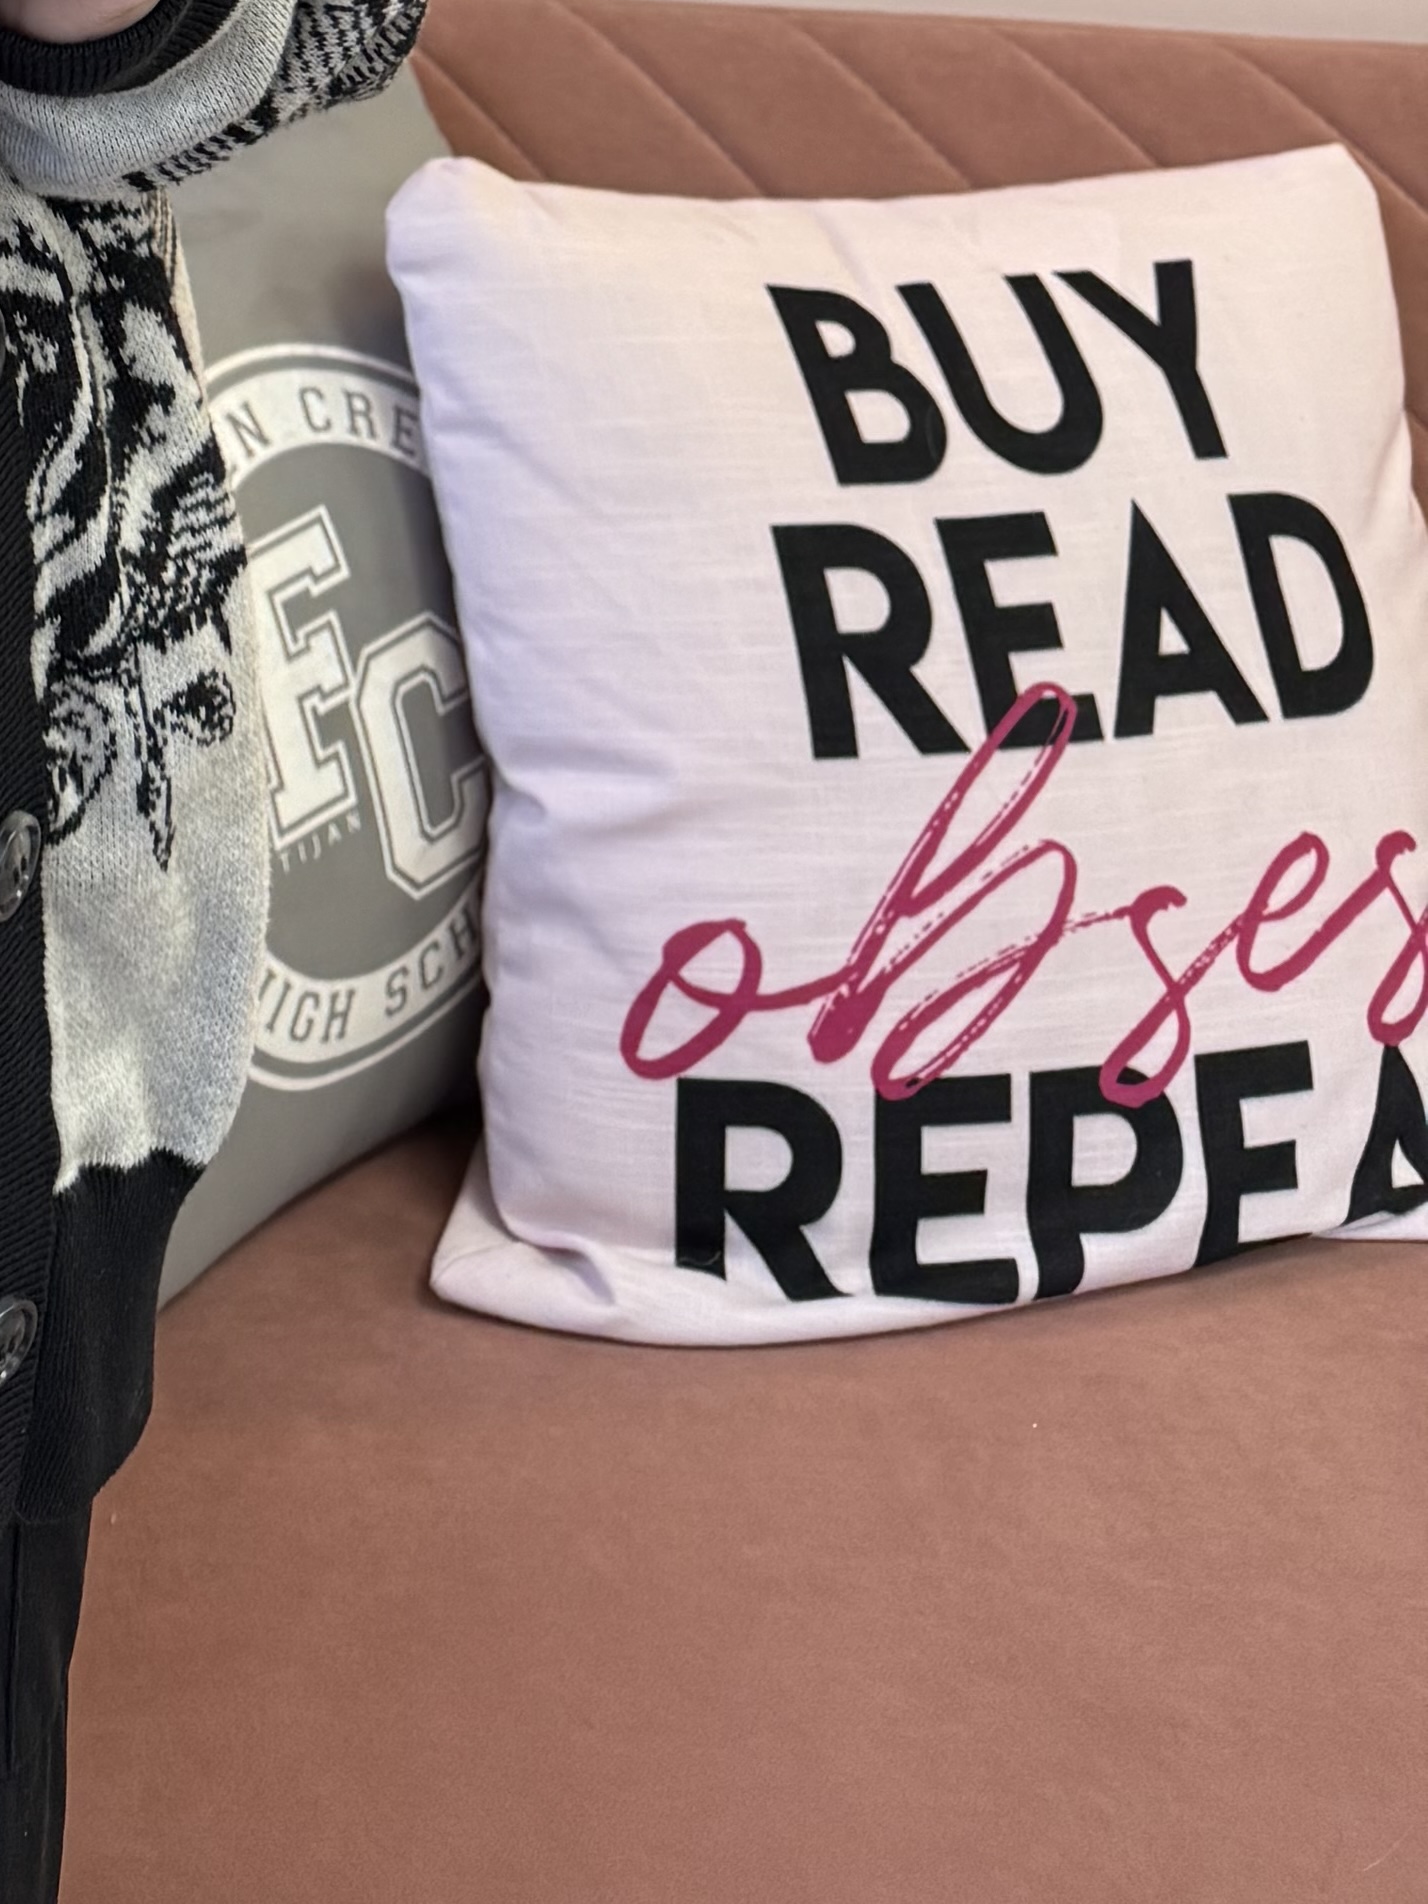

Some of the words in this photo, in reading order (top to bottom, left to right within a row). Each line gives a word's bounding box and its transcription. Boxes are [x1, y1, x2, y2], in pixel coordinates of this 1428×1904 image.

[765, 258, 1228, 487] BUY
[771, 492, 1375, 761] READ
[383, 899, 479, 1017] SCH
[620, 681, 1428, 1108] obses
[675, 1040, 1428, 1304] REPEA
